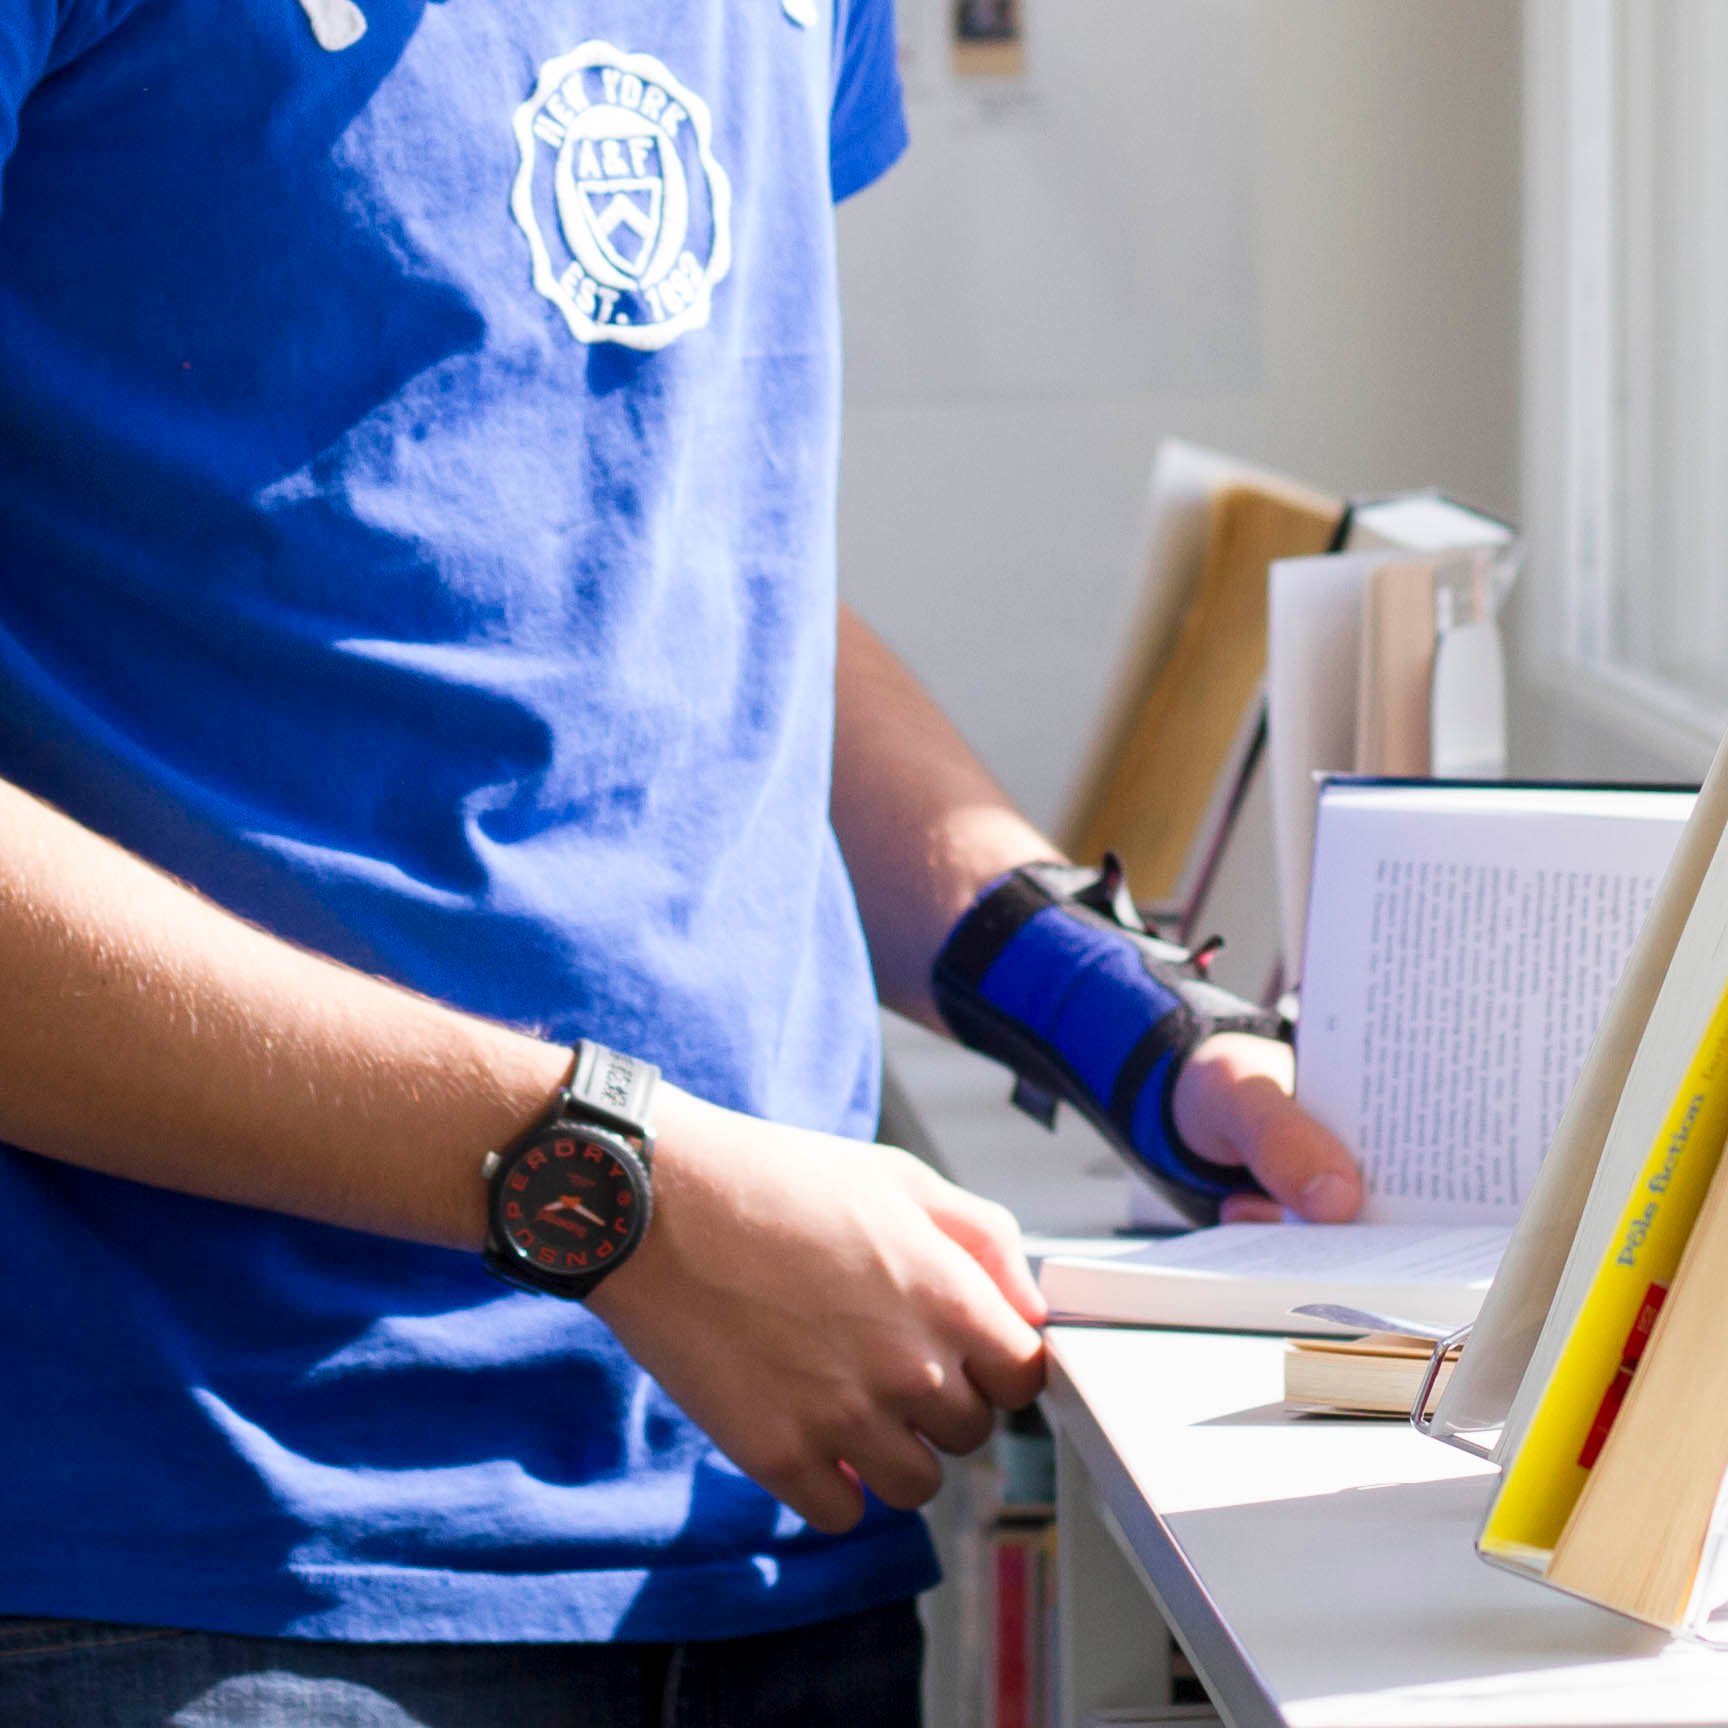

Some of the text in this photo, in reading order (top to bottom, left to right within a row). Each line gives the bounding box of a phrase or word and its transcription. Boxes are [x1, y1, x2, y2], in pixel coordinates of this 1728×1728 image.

[601, 68, 688, 138] YORK
[578, 136, 655, 179] A&F
[1647, 1092, 1706, 1196] fiction
